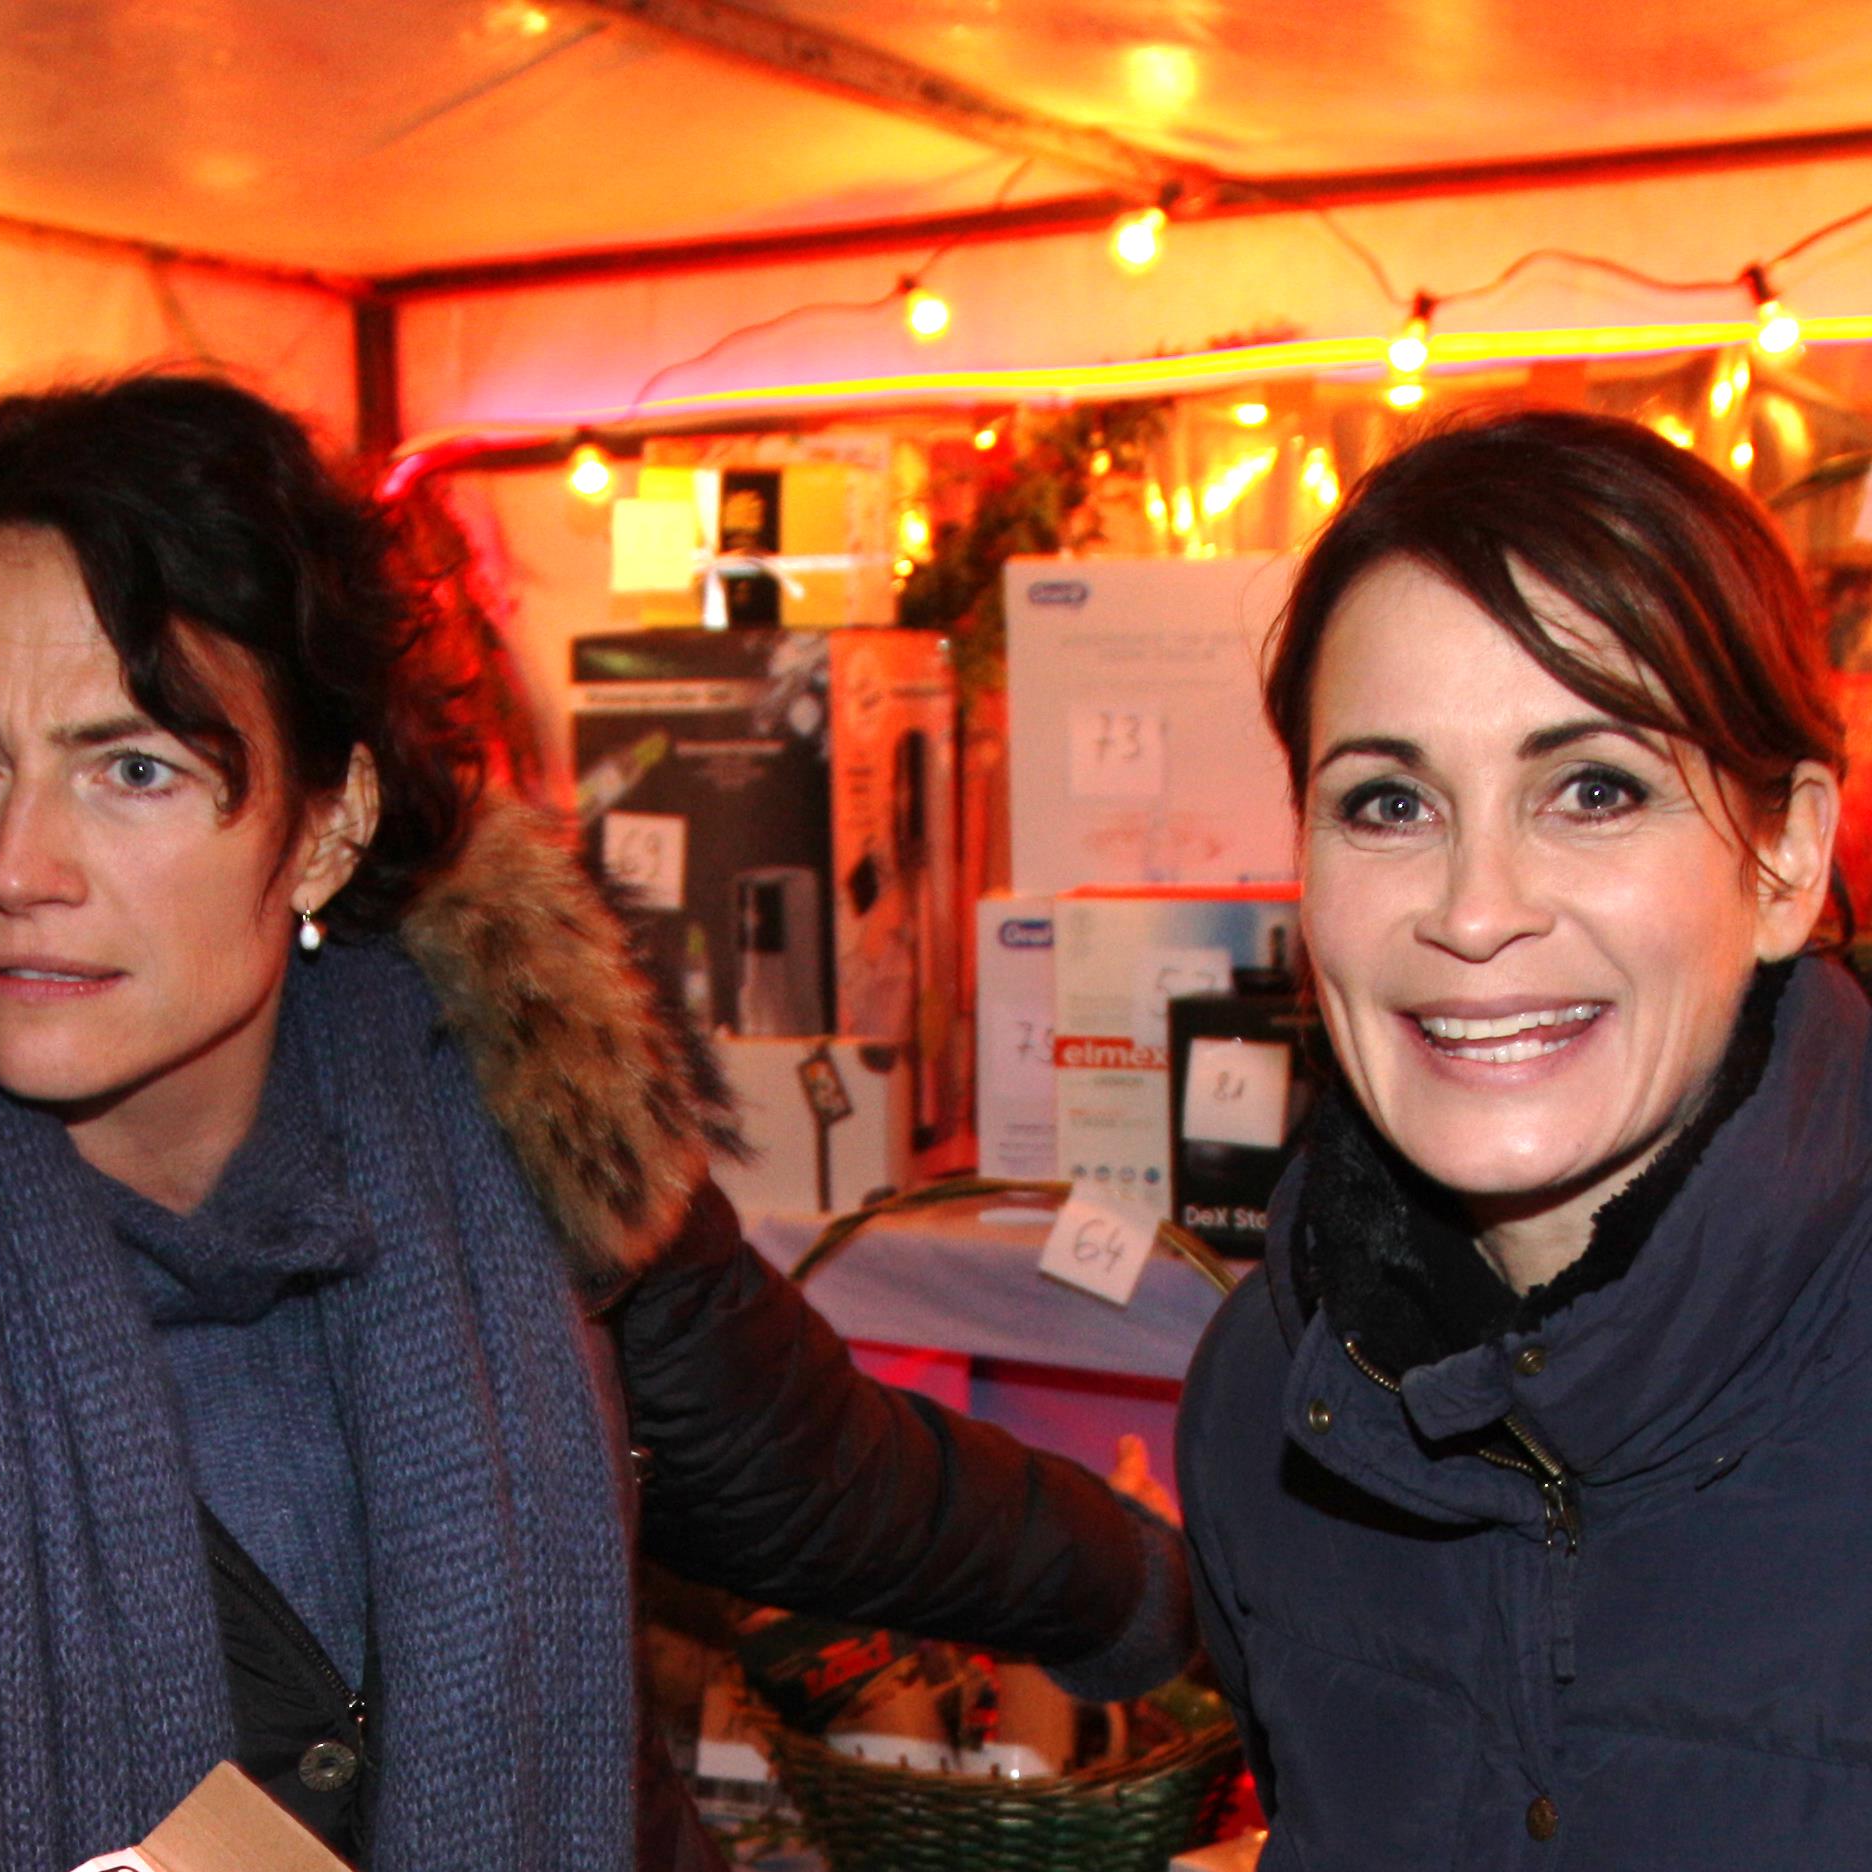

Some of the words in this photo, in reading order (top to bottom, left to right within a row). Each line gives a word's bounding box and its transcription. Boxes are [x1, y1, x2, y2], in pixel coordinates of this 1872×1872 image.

[1065, 1041, 1168, 1067] elmex
[1184, 1206, 1227, 1226] DeX
[1073, 1218, 1126, 1274] 64
